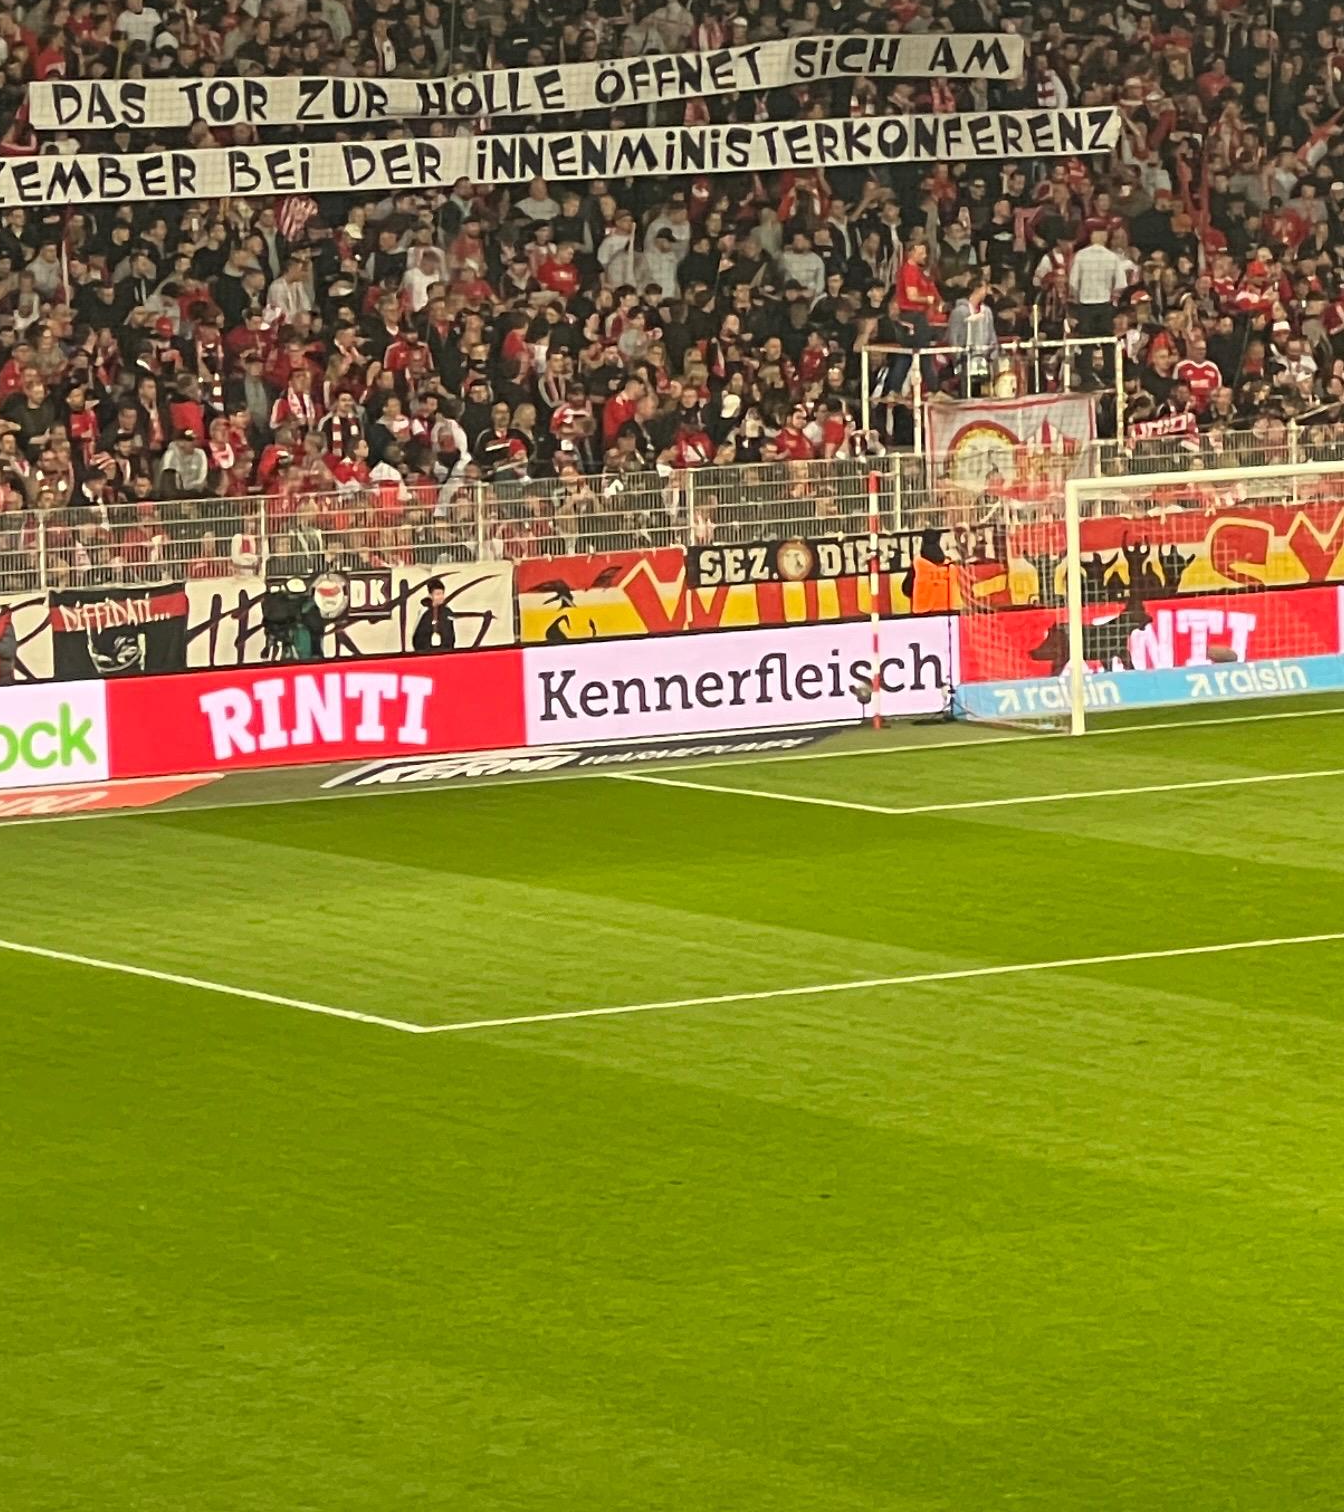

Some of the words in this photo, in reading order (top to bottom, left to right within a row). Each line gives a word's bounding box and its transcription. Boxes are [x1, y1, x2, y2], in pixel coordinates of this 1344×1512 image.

[53, 80, 147, 126] DAS
[178, 79, 267, 124] TOR
[295, 79, 390, 121] ZUR
[594, 46, 763, 104] ÖFFNET
[928, 38, 1011, 74] AM
[342, 143, 442, 186] DER
[199, 672, 434, 761] RINTI
[537, 641, 946, 722] Kennerfleisch
[1214, 660, 1308, 698] raisin
